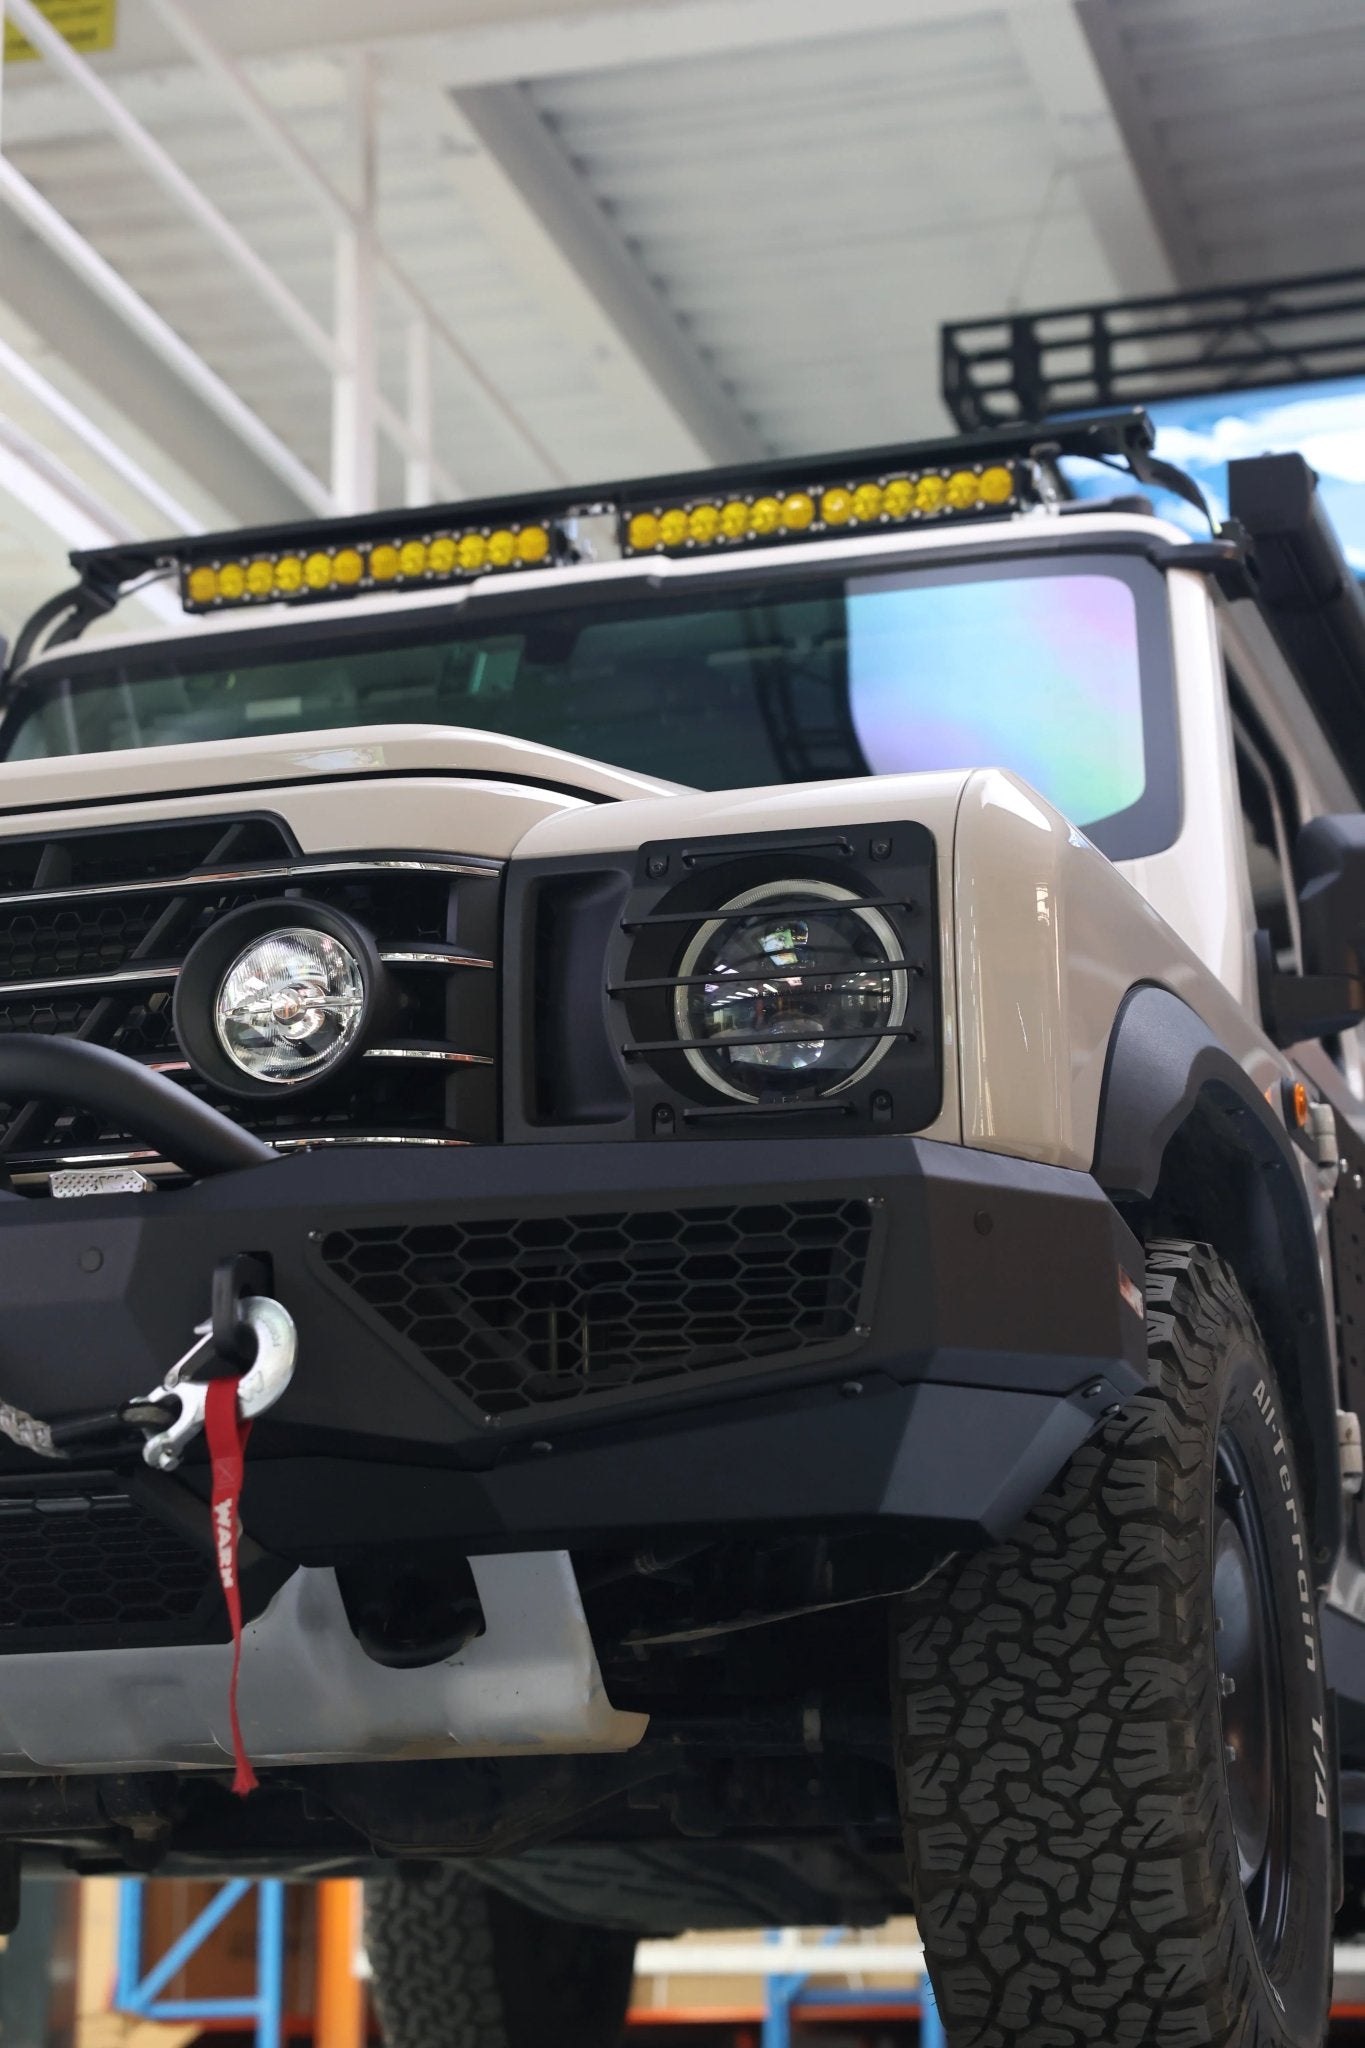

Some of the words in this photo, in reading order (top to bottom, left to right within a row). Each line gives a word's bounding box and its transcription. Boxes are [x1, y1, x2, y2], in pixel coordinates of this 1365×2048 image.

[213, 1498, 234, 1588] WARN
[1252, 1379, 1316, 1672] All-Terrain
[1311, 1714, 1328, 1819] T/A
